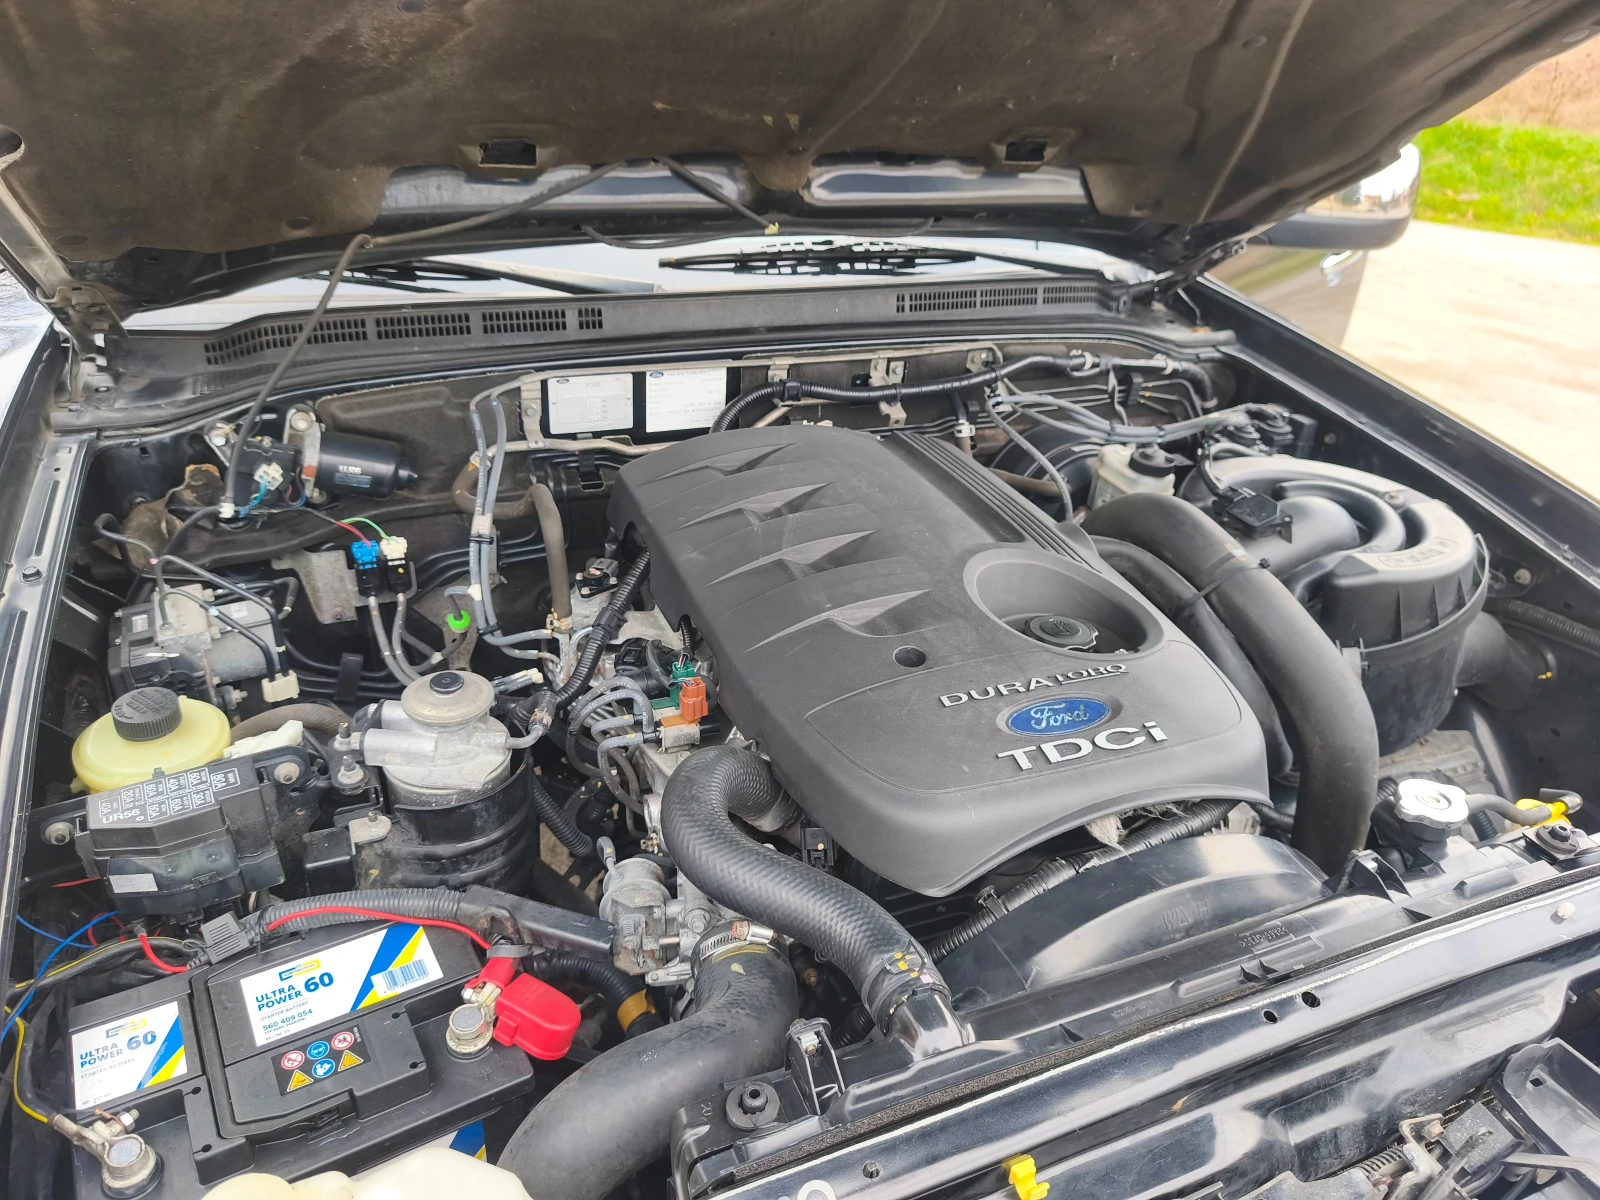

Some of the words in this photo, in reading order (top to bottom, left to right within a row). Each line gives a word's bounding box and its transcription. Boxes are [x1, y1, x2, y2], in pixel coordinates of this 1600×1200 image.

[940, 663, 1129, 708] DURATORQ
[1031, 703, 1090, 730] Ford
[996, 721, 1169, 771] TDCi
[255, 984, 296, 1003] ULTRA
[304, 972, 334, 993] 60
[257, 990, 303, 1011] POWER
[263, 1021, 279, 1032] 560
[280, 1014, 296, 1024] 409
[297, 1008, 313, 1018] 054
[80, 1042, 118, 1060] ULTRA
[126, 1030, 157, 1051] 60
[80, 1048, 124, 1069] POWER
